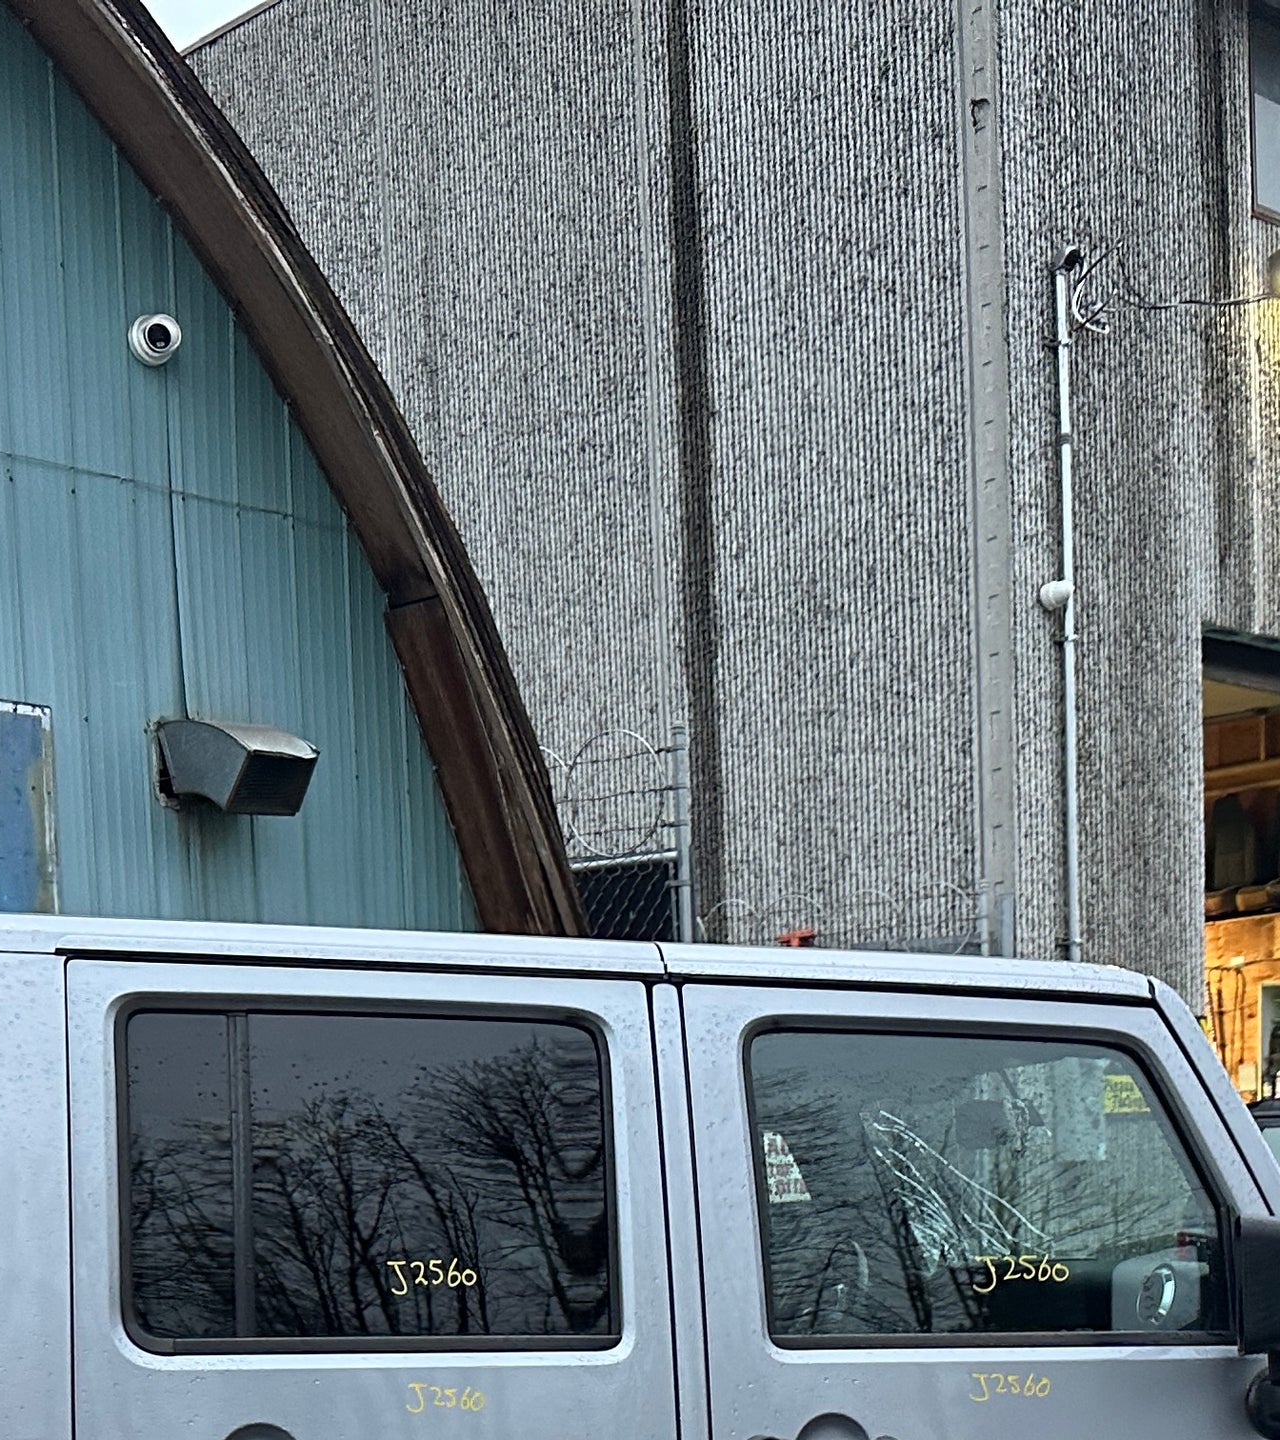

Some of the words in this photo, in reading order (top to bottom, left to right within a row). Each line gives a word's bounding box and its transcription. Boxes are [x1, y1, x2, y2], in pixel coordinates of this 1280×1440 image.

[386, 1257, 478, 1296] J2560
[972, 1253, 1070, 1294] J2560
[406, 1381, 486, 1414] J2560
[970, 1372, 1052, 1402] J2560
